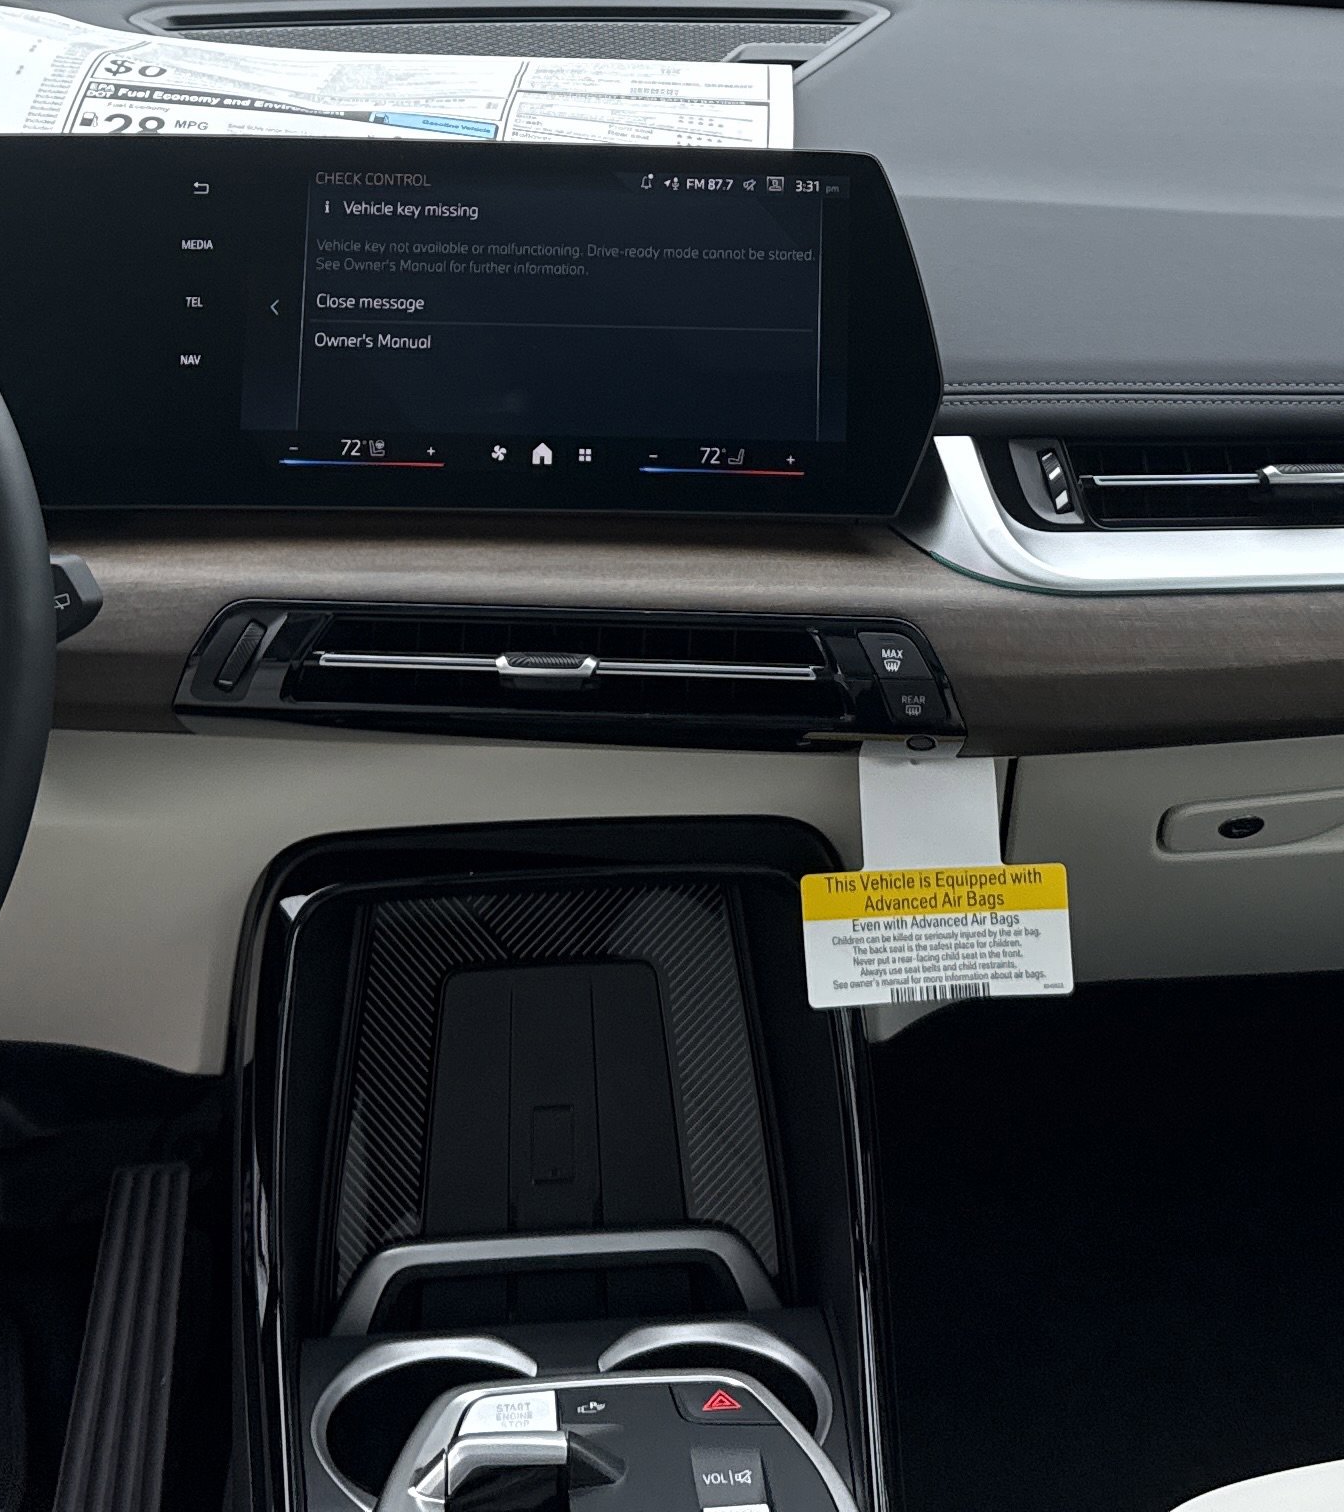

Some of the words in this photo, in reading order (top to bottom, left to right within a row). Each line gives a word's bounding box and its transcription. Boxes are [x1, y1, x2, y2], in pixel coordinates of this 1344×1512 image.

[104, 59, 168, 78] $0
[86, 90, 112, 99] DOT
[90, 82, 115, 92] EPA
[118, 88, 149, 100] Fuel
[153, 91, 221, 106] Economy
[223, 97, 251, 107] and
[107, 101, 127, 109] Fuel
[129, 104, 171, 113] Economy
[174, 119, 209, 131] MPG
[422, 119, 460, 129] Gasoline
[461, 124, 491, 134] Vehicle
[315, 172, 362, 186] CHECK
[365, 173, 432, 188] CONTROL
[686, 178, 705, 190] FM
[708, 178, 734, 191] 87.7
[795, 179, 820, 193] 3:31
[825, 184, 839, 194] pm
[343, 201, 394, 217] Vehicle
[397, 202, 421, 219] key
[425, 203, 479, 220] missing
[181, 239, 213, 250] MEDIA
[316, 239, 361, 253] Vehicle
[365, 241, 387, 256] key
[390, 242, 410, 254] not
[413, 241, 468, 255] available
[472, 244, 484, 255] or
[487, 242, 584, 258] malfunctioning.
[587, 245, 660, 260] Drive-ready
[663, 246, 699, 259] mode
[702, 248, 745, 260] cannot
[749, 248, 765, 260] be
[768, 249, 815, 262] started.
[316, 259, 341, 271] See
[344, 259, 396, 273] Owner's
[400, 260, 447, 273] Manual
[449, 260, 466, 273] for
[469, 261, 511, 274] further
[513, 263, 589, 275] information.
[185, 296, 204, 308] TEL
[316, 294, 356, 309] Close
[359, 297, 425, 313] message
[314, 332, 374, 348] Owner's
[377, 334, 431, 349] Manual
[180, 354, 201, 366] NAV
[881, 649, 903, 659] MAX
[902, 696, 926, 704] REAR
[824, 876, 856, 893] This
[860, 872, 915, 891] Vehicle
[919, 872, 931, 888] is
[935, 868, 1007, 894] Equipped
[1010, 868, 1042, 885] with
[864, 892, 938, 912] Advanced
[942, 892, 963, 908] Air
[967, 891, 1004, 910] Bags
[852, 918, 880, 932] Even
[883, 916, 908, 930] with
[910, 914, 968, 928] Advanced
[971, 912, 988, 926] Air
[990, 912, 1020, 927] Bags
[832, 934, 864, 946] Children
[866, 936, 879, 944] can
[881, 934, 892, 942] be
[893, 932, 913, 942] killed
[924, 930, 958, 942] seriously
[960, 930, 987, 940] injured
[988, 930, 998, 939] by
[999, 928, 1012, 937] the
[1013, 928, 1024, 936] air
[1025, 926, 1041, 938] bag.
[853, 945, 868, 955] The
[869, 944, 888, 954] back
[889, 943, 906, 953] seat
[915, 942, 928, 951] the
[929, 940, 952, 950] safest
[954, 939, 975, 951] place
[977, 938, 988, 948] for
[988, 936, 1022, 949] children.
[853, 956, 876, 966] Never
[877, 956, 890, 966] put
[898, 952, 940, 964] rear-facing
[941, 950, 960, 960] child
[962, 950, 978, 960] seat
[988, 948, 1001, 958] the
[1002, 946, 1023, 958] front.
[860, 966, 887, 978] Always
[888, 966, 903, 974] use
[904, 964, 920, 974] seat
[922, 963, 941, 973] belts
[942, 962, 956, 972] and
[958, 960, 977, 970] child
[978, 959, 1017, 970] restraints.
[833, 980, 848, 990] See
[850, 978, 880, 989] owner's
[881, 976, 910, 987] manual
[911, 974, 922, 984] for
[923, 974, 943, 984] more
[944, 970, 990, 982] information
[990, 968, 1012, 980] about
[1014, 968, 1023, 978] air
[1024, 968, 1046, 980] bags.
[496, 1402, 530, 1412] START
[496, 1411, 533, 1421] ENGINE
[502, 1420, 529, 1428] STOP
[702, 1472, 728, 1485] VOL
